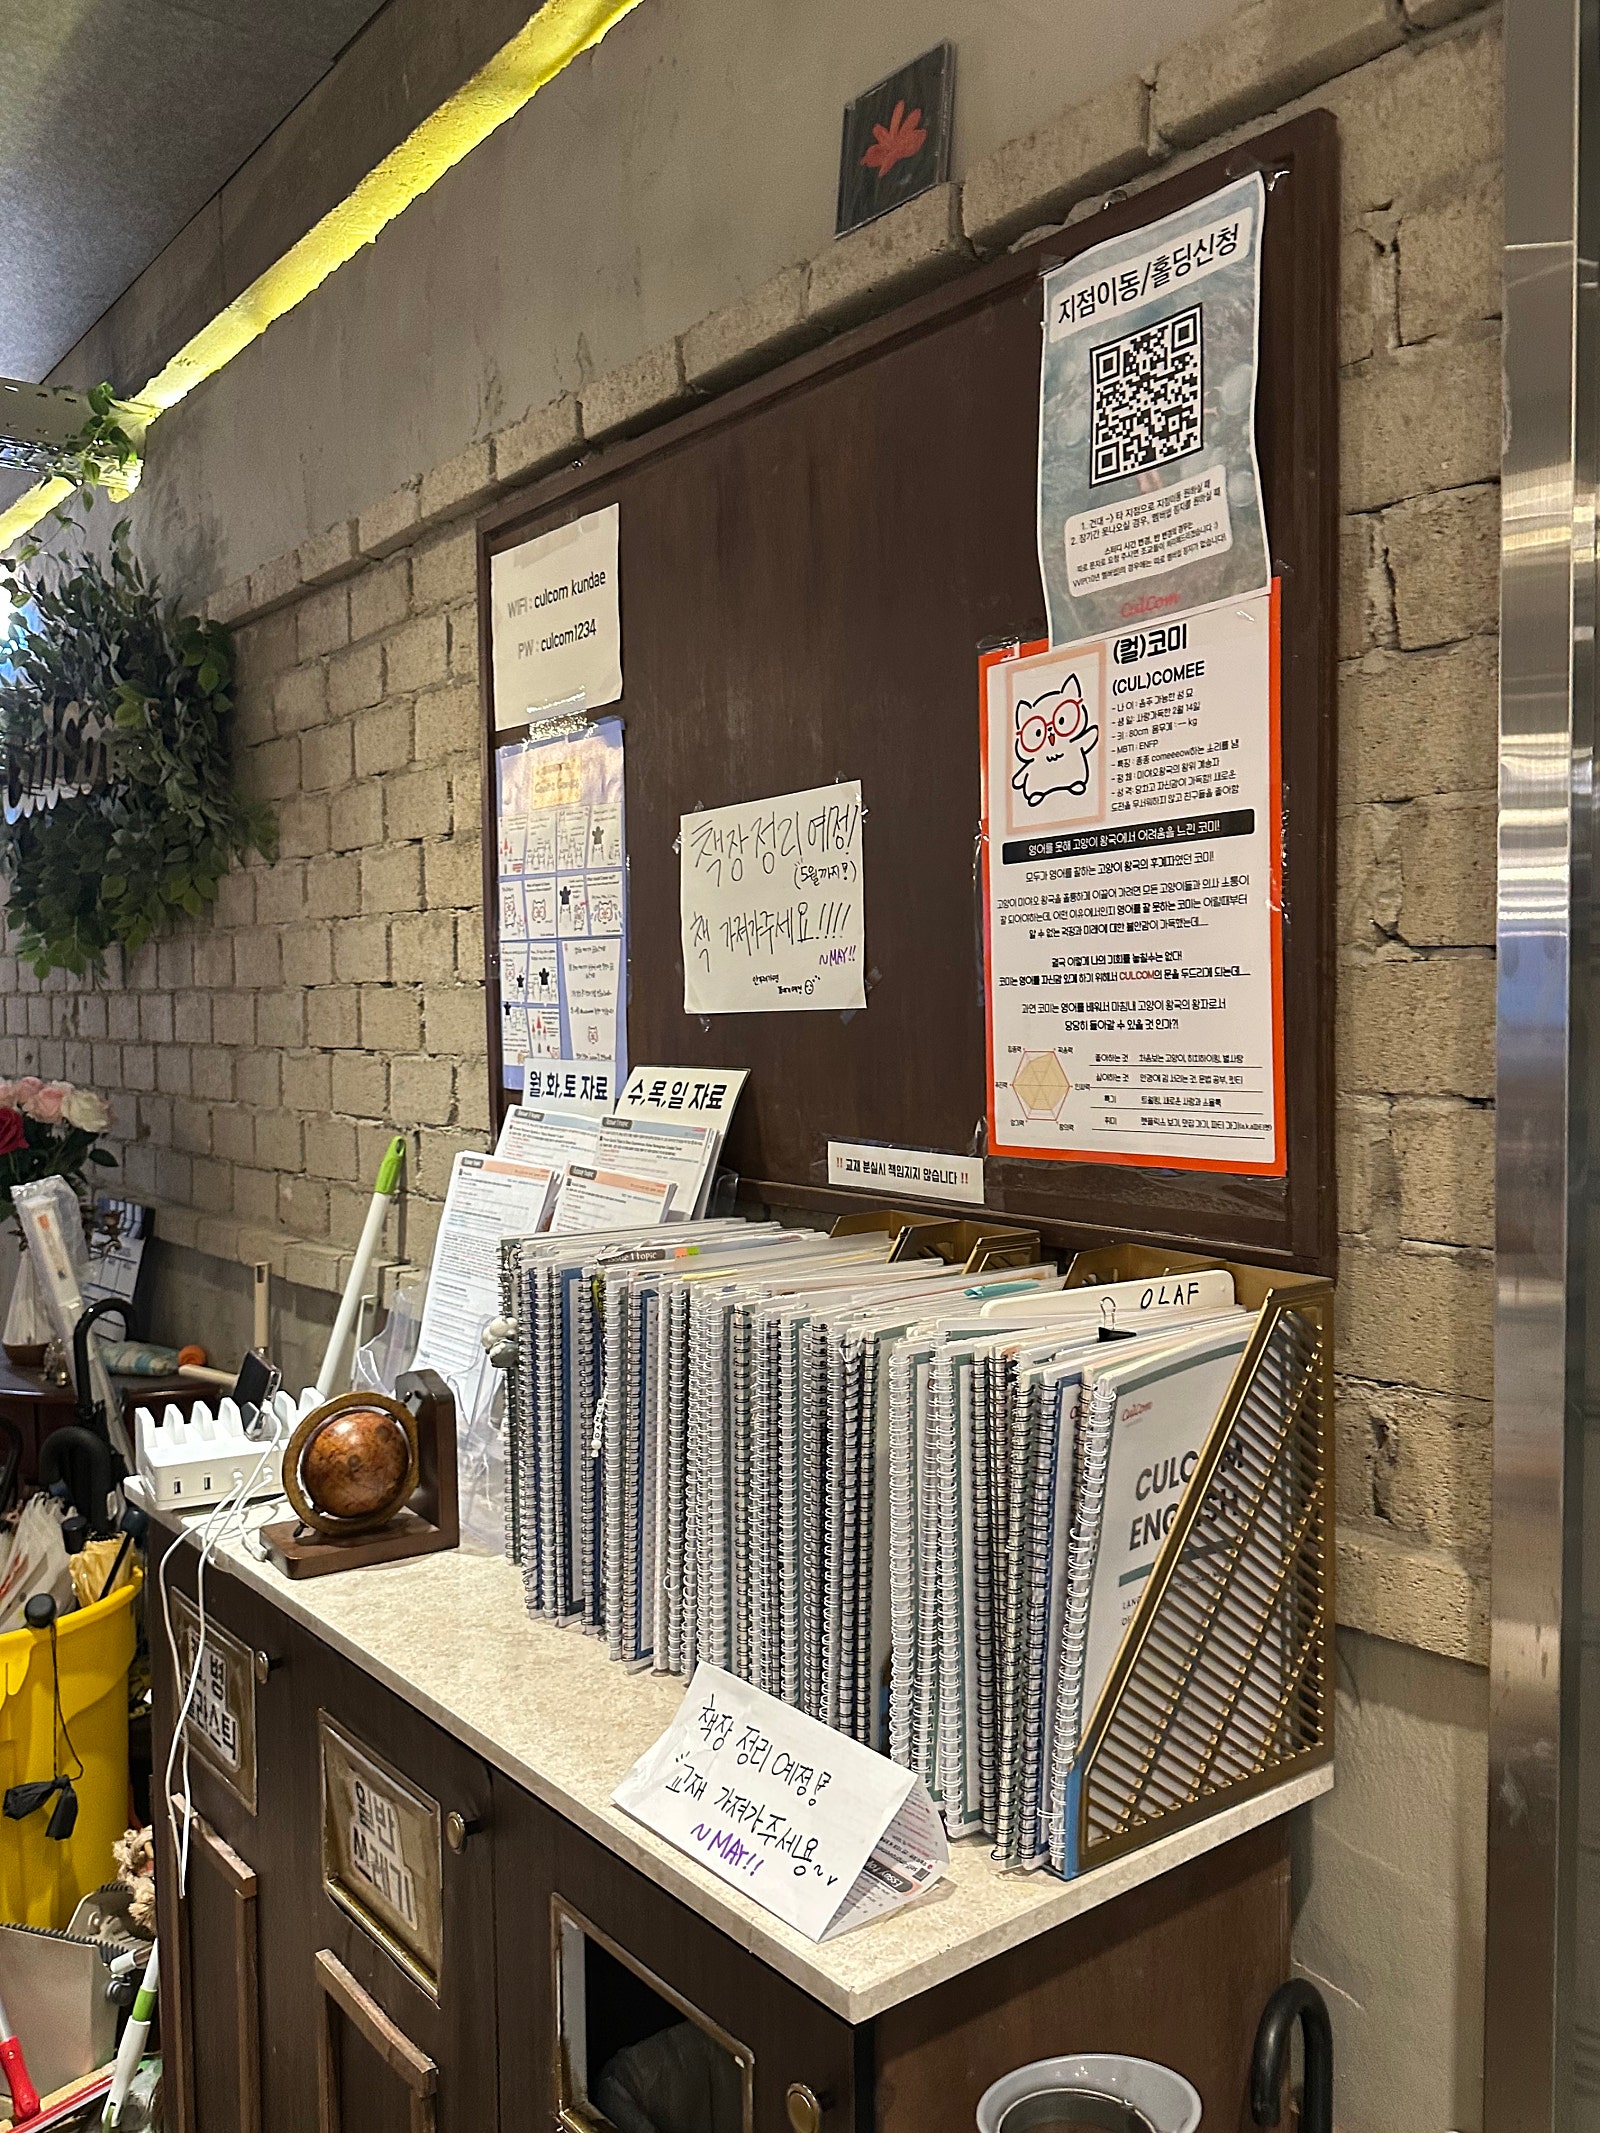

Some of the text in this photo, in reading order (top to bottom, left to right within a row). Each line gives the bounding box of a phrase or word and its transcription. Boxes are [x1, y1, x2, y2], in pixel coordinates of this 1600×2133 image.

[1058, 223, 1238, 323] 지점이동/홀딩신청
[1126, 502, 1154, 517] 지점으로
[1080, 529, 1100, 543] 장기간
[534, 584, 569, 609] culcom
[571, 570, 606, 596] kundae
[518, 618, 597, 659] PW culcom1234
[1113, 624, 1187, 664] (컬)코미
[1112, 660, 1205, 695] (CUL)COMEE
[1028, 841, 1053, 856] 영어를
[1055, 840, 1071, 853] 못해
[1072, 836, 1098, 850] 고양이
[1100, 832, 1136, 848] 왕국에서
[1137, 825, 1174, 842] 어려움을
[1176, 822, 1196, 837] 느낀
[1025, 869, 1048, 883] 모두가
[1049, 866, 1072, 880] 영어를
[1074, 864, 1096, 878] 잘하는
[1097, 860, 1123, 875] 고양이
[1124, 858, 1149, 872] 왕국의
[997, 898, 1017, 909] 고양이
[1041, 894, 1062, 905] 왕국을
[1063, 890, 1091, 903] 훌륭하게
[1092, 888, 1117, 899] 이끌어
[1118, 886, 1141, 897] 가려면
[1143, 884, 1158, 895] 모든
[1160, 880, 1200, 893] 고양이들과
[1053, 910, 1068, 920] 어떤
[1069, 905, 1116, 919] 이유에서인지
[1117, 903, 1141, 915] 영어를
[1152, 901, 1176, 913] 못하는
[1177, 898, 1201, 910] 코미는
[1046, 928, 1060, 938] 없는
[1084, 923, 1108, 934] 미래에
[1110, 923, 1124, 933] 대한
[1127, 920, 1159, 932] 불안감이
[1052, 957, 1066, 968] 결국
[1067, 955, 1090, 966] 이렇게
[1091, 954, 1106, 965] 나의
[1107, 953, 1130, 965] 기회를
[999, 966, 1213, 986] 코미는 영어를 자신감 있게 하기 위해서 CULCOM의 문을 두드리게
[1021, 998, 1226, 1014] 과연 코미는 영어를 배워서 마침내 고양이 왕국의 왕자로서
[1065, 1020, 1088, 1031] 당당히
[1089, 1019, 1115, 1031] 돌아갈
[1117, 1019, 1125, 1030] 수
[1127, 1019, 1143, 1030] 있을
[1145, 1019, 1154, 1030] 것
[530, 1070, 608, 1101] 월,화,토 자료
[628, 1078, 728, 1110] 수,목,일 자료
[845, 1158, 860, 1172] 교재
[862, 1160, 886, 1176] 분실시
[888, 1164, 921, 1180] 책임지지
[923, 1168, 958, 1185] 않습니다
[1140, 1282, 1201, 1310] OLAF
[698, 1693, 733, 1751] 책장
[736, 1726, 773, 1774] 정리
[355, 1781, 396, 1855] 일반
[354, 1826, 413, 1922] 쓰레기
